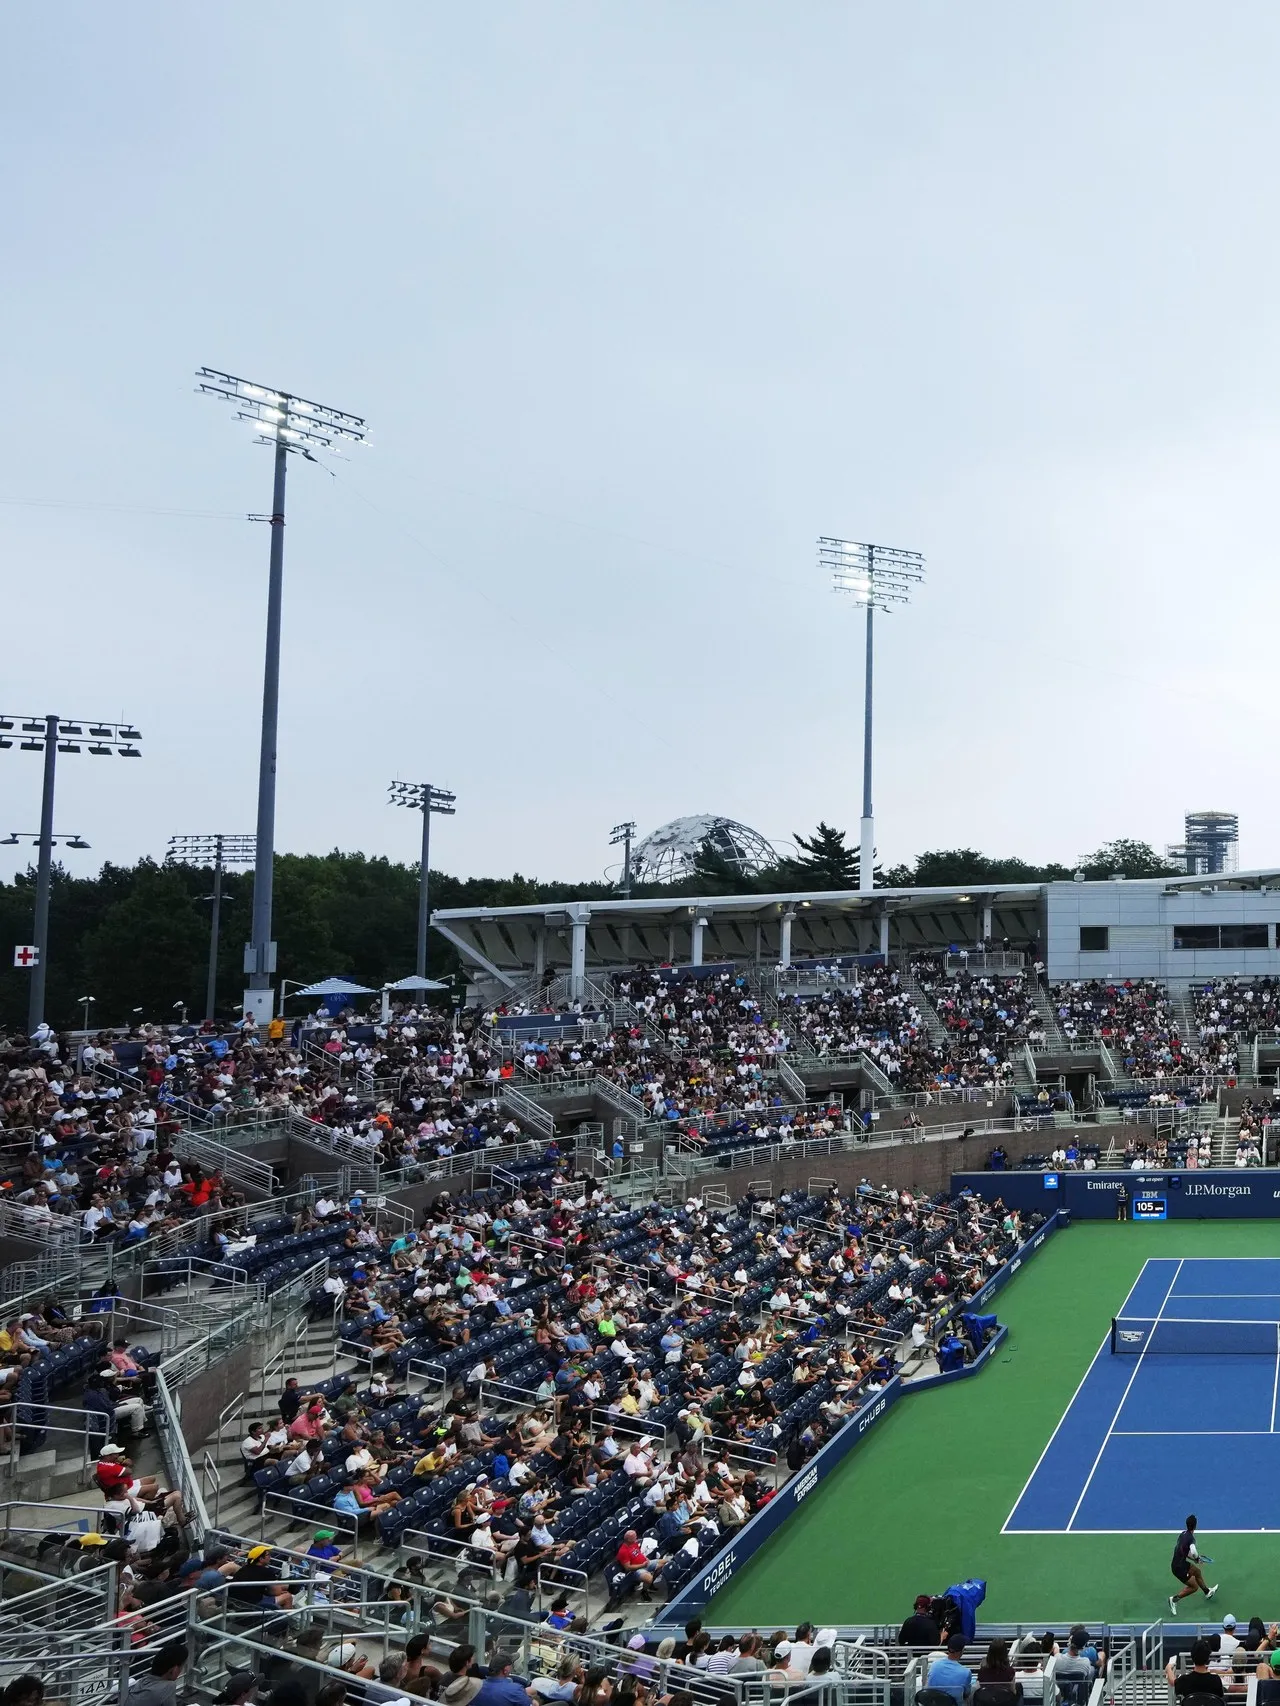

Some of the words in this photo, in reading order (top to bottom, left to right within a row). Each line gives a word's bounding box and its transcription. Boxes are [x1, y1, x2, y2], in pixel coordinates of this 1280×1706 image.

[1087, 1181, 1123, 1190] Emirates
[1185, 1184, 1250, 1198] J.P.Morgan
[1136, 1202, 1154, 1211] 105
[859, 1398, 886, 1432] CHUBB
[794, 1465, 818, 1496] AMERICAN
[797, 1474, 818, 1502] EXPRESS
[704, 1550, 736, 1592] DOBEL
[710, 1568, 732, 1596] TEQUILA
[80, 1680, 105, 1694] 14A
